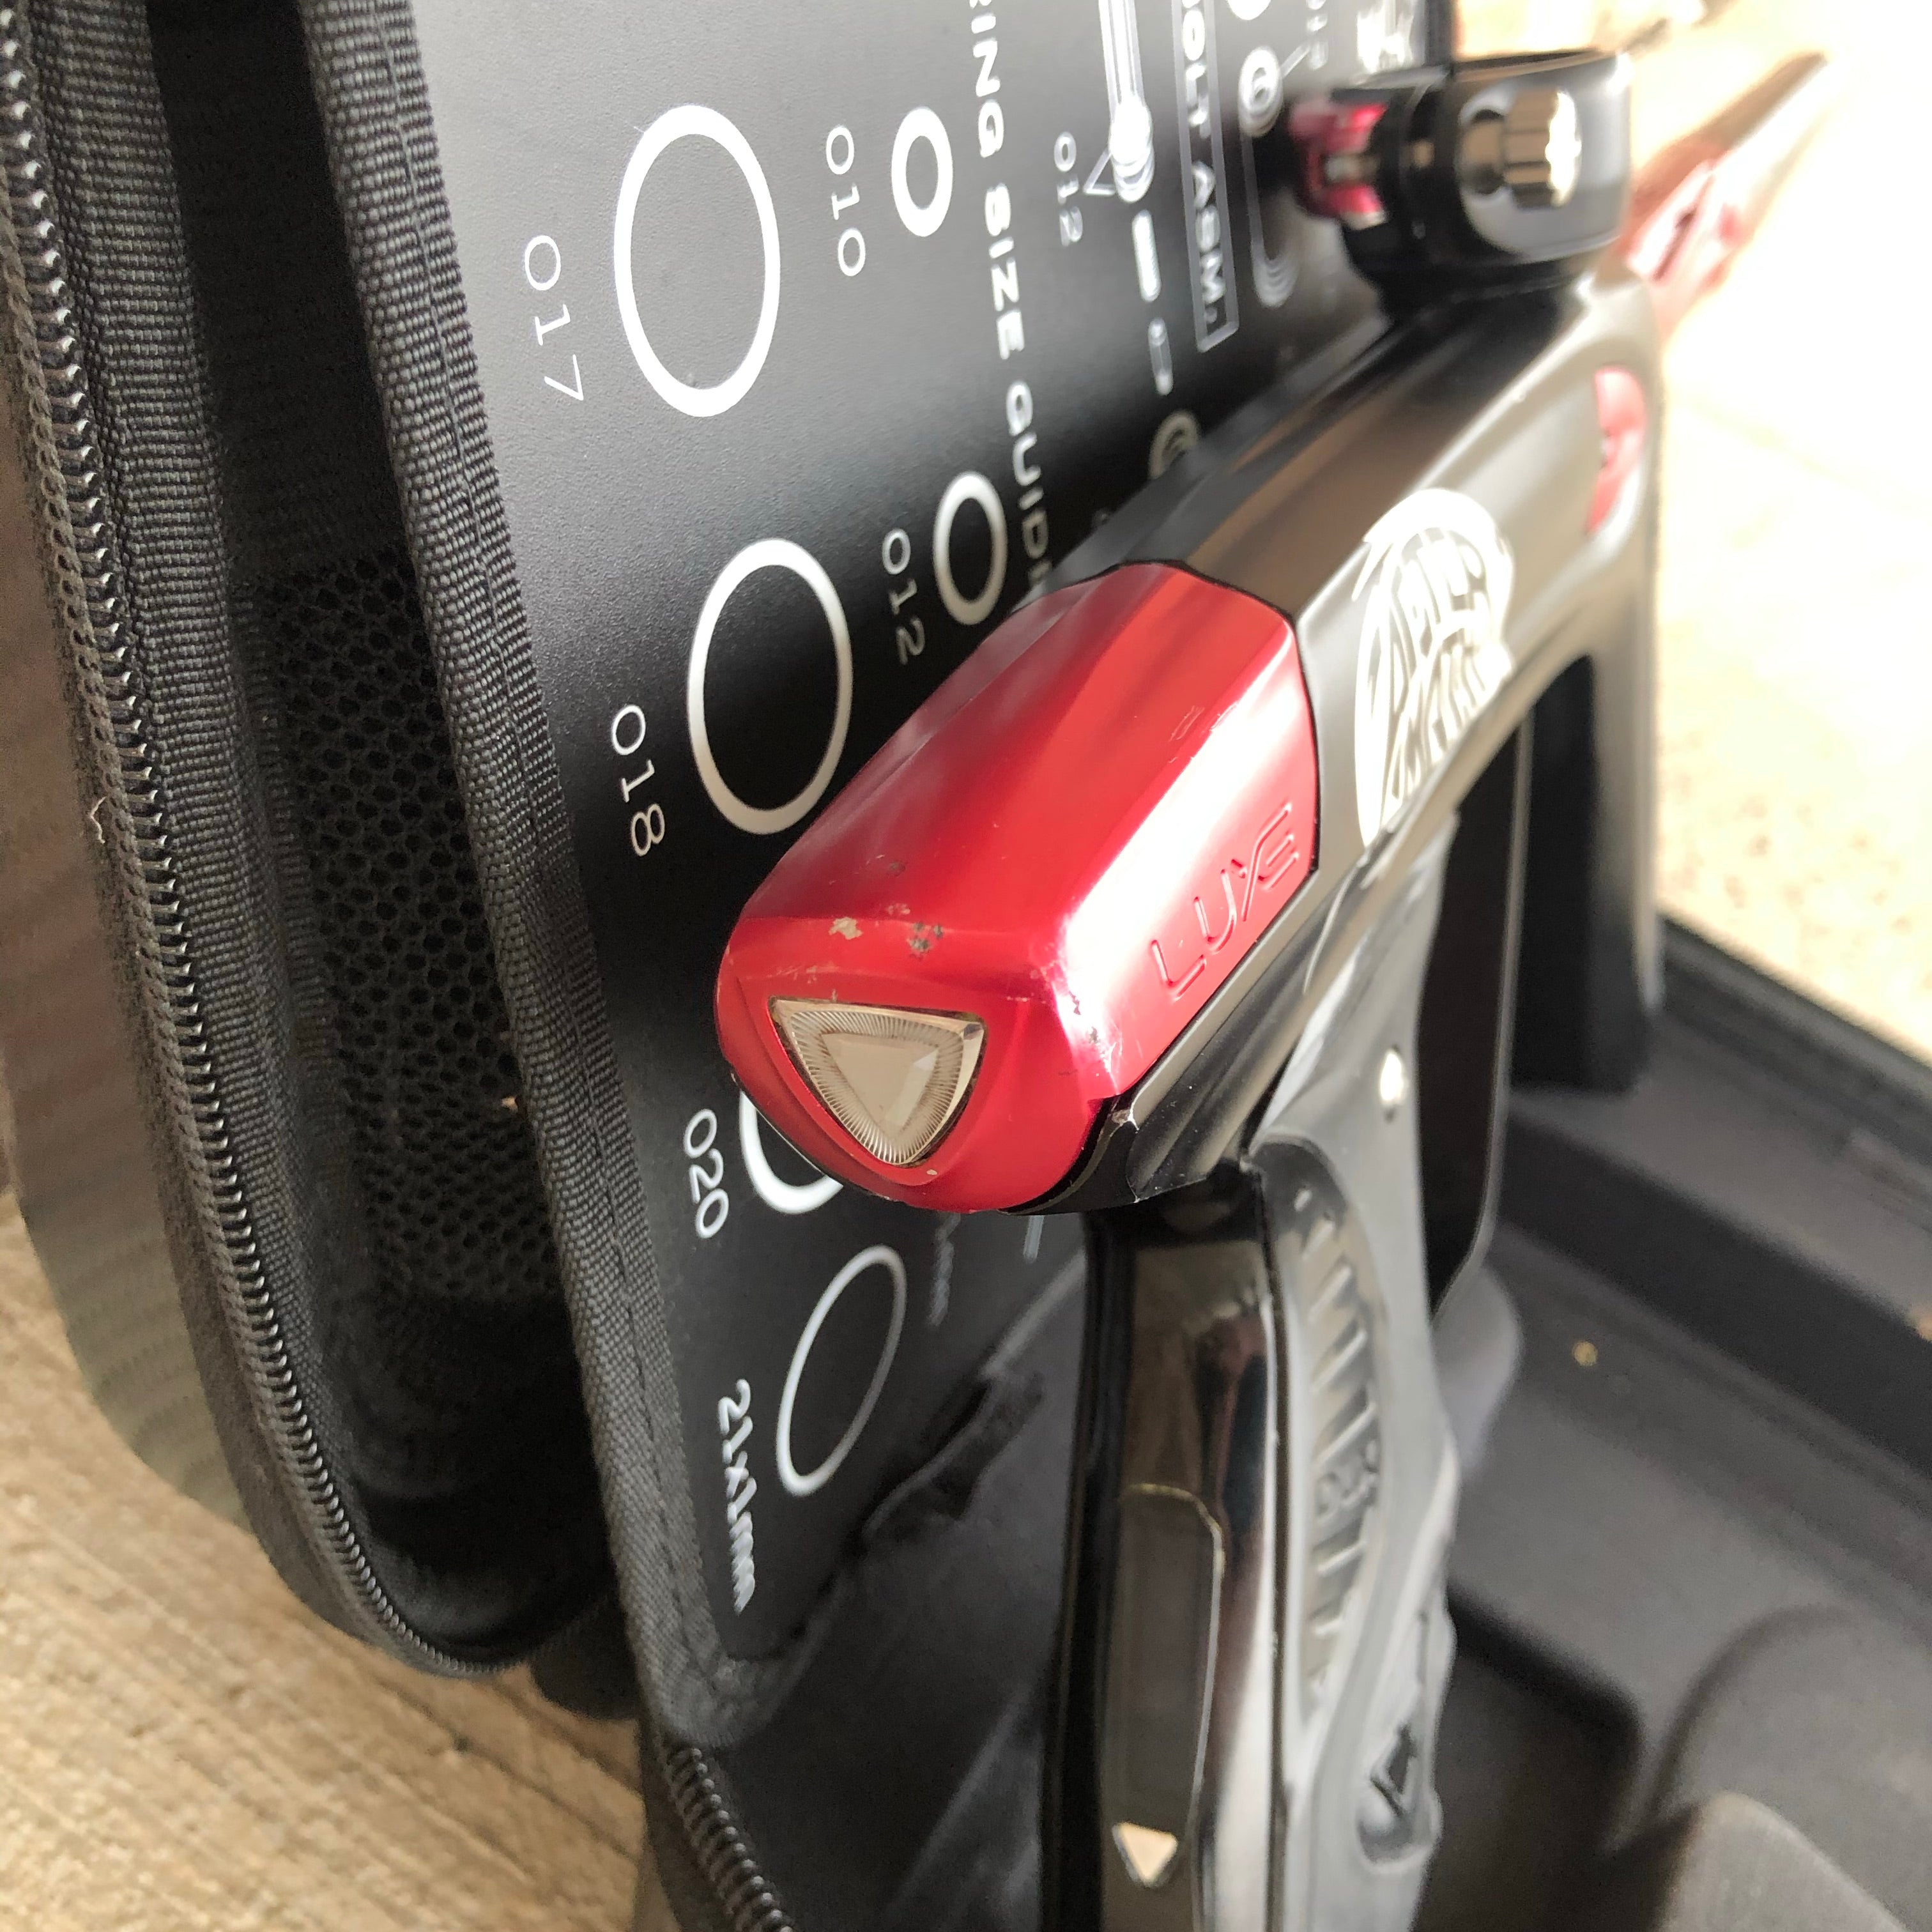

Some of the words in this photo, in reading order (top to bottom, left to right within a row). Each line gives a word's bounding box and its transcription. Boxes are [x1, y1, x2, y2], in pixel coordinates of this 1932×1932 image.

[969, 0, 1004, 158] ING
[1181, 0, 1211, 139] OLT
[825, 126, 866, 276] 010
[1054, 132, 1083, 247] 012
[524, 235, 584, 401] 017
[985, 183, 1025, 360] SIZE
[882, 529, 925, 665] 012
[611, 704, 665, 857] 018
[1149, 800, 1301, 1004] LUXE
[683, 1108, 729, 1239] 020
